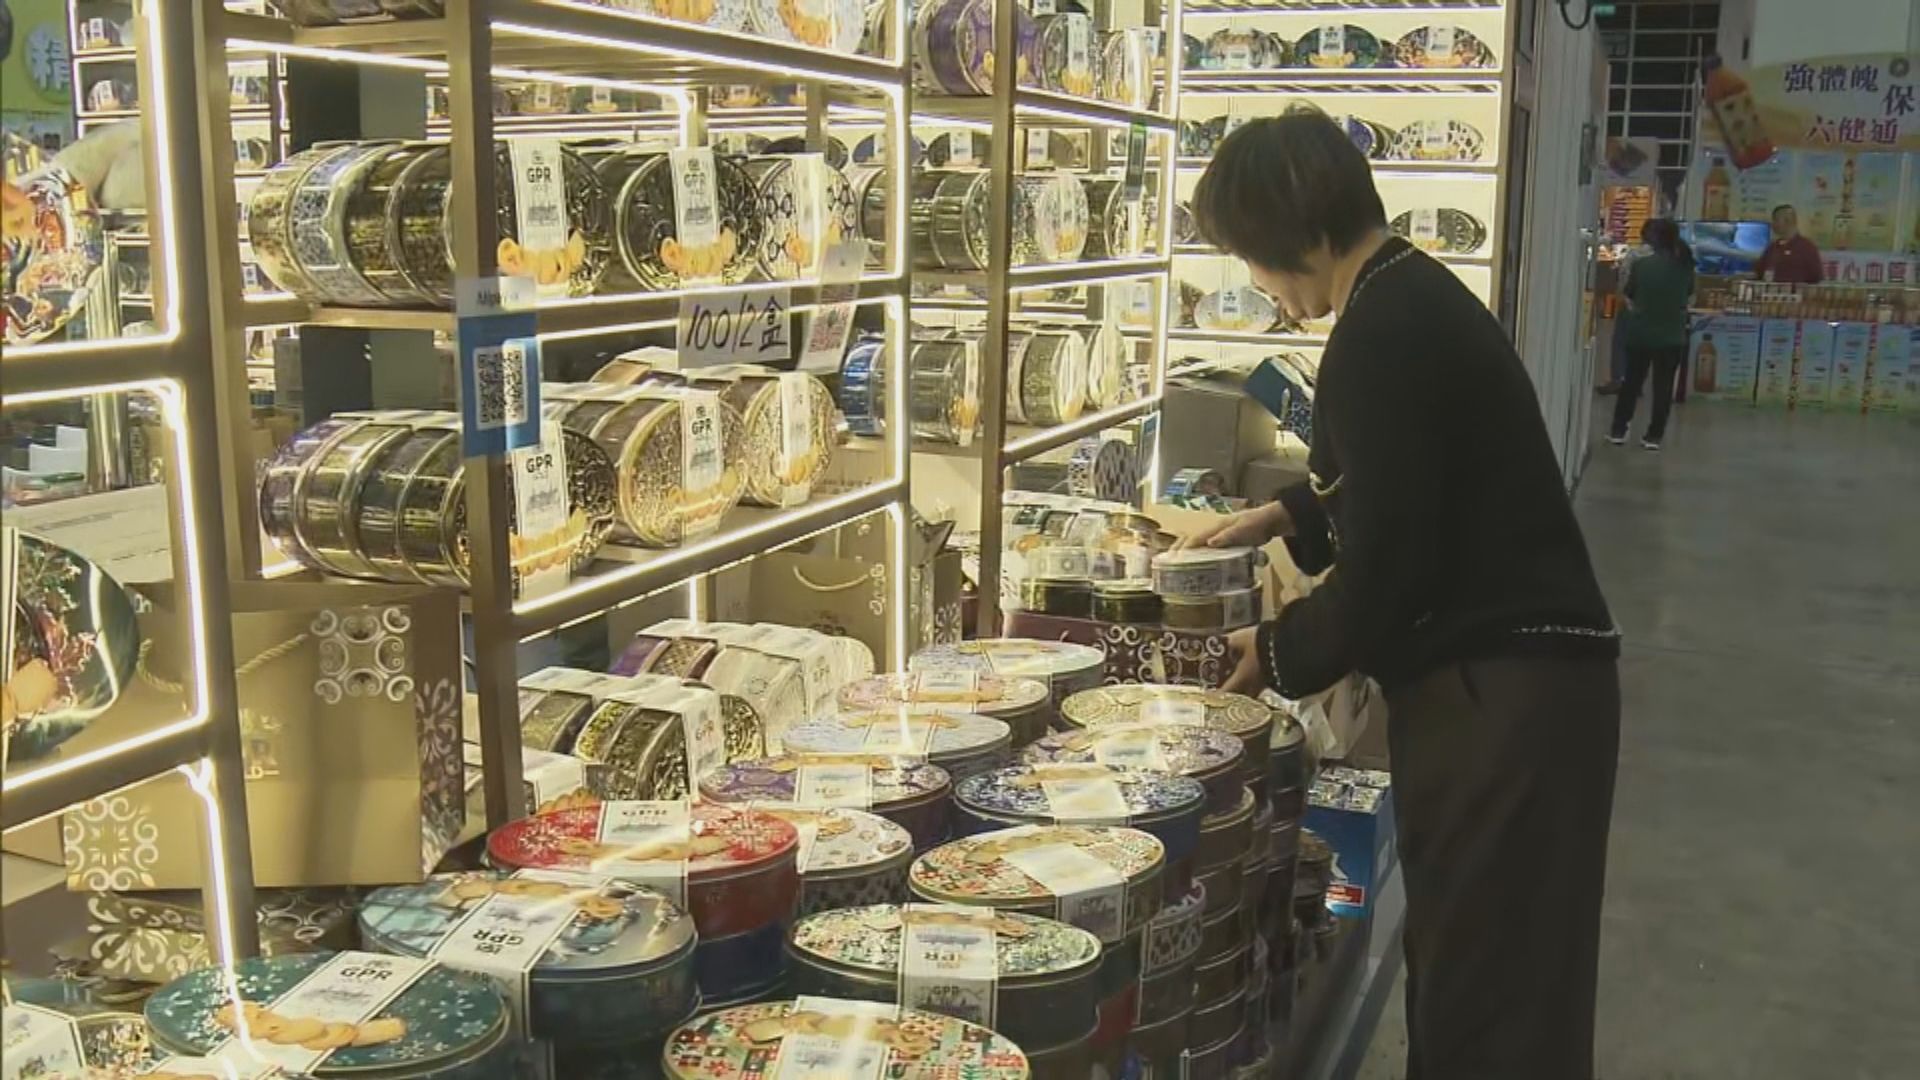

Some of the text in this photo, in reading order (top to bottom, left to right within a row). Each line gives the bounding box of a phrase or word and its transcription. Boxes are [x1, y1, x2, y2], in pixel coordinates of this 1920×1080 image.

[1883, 84, 1915, 116] 保
[526, 167, 553, 184] GPR
[683, 173, 706, 188] GPR
[691, 418, 713, 436] GPR
[525, 453, 554, 474] GPR
[473, 929, 525, 945] GPR
[340, 968, 393, 980] GPR
